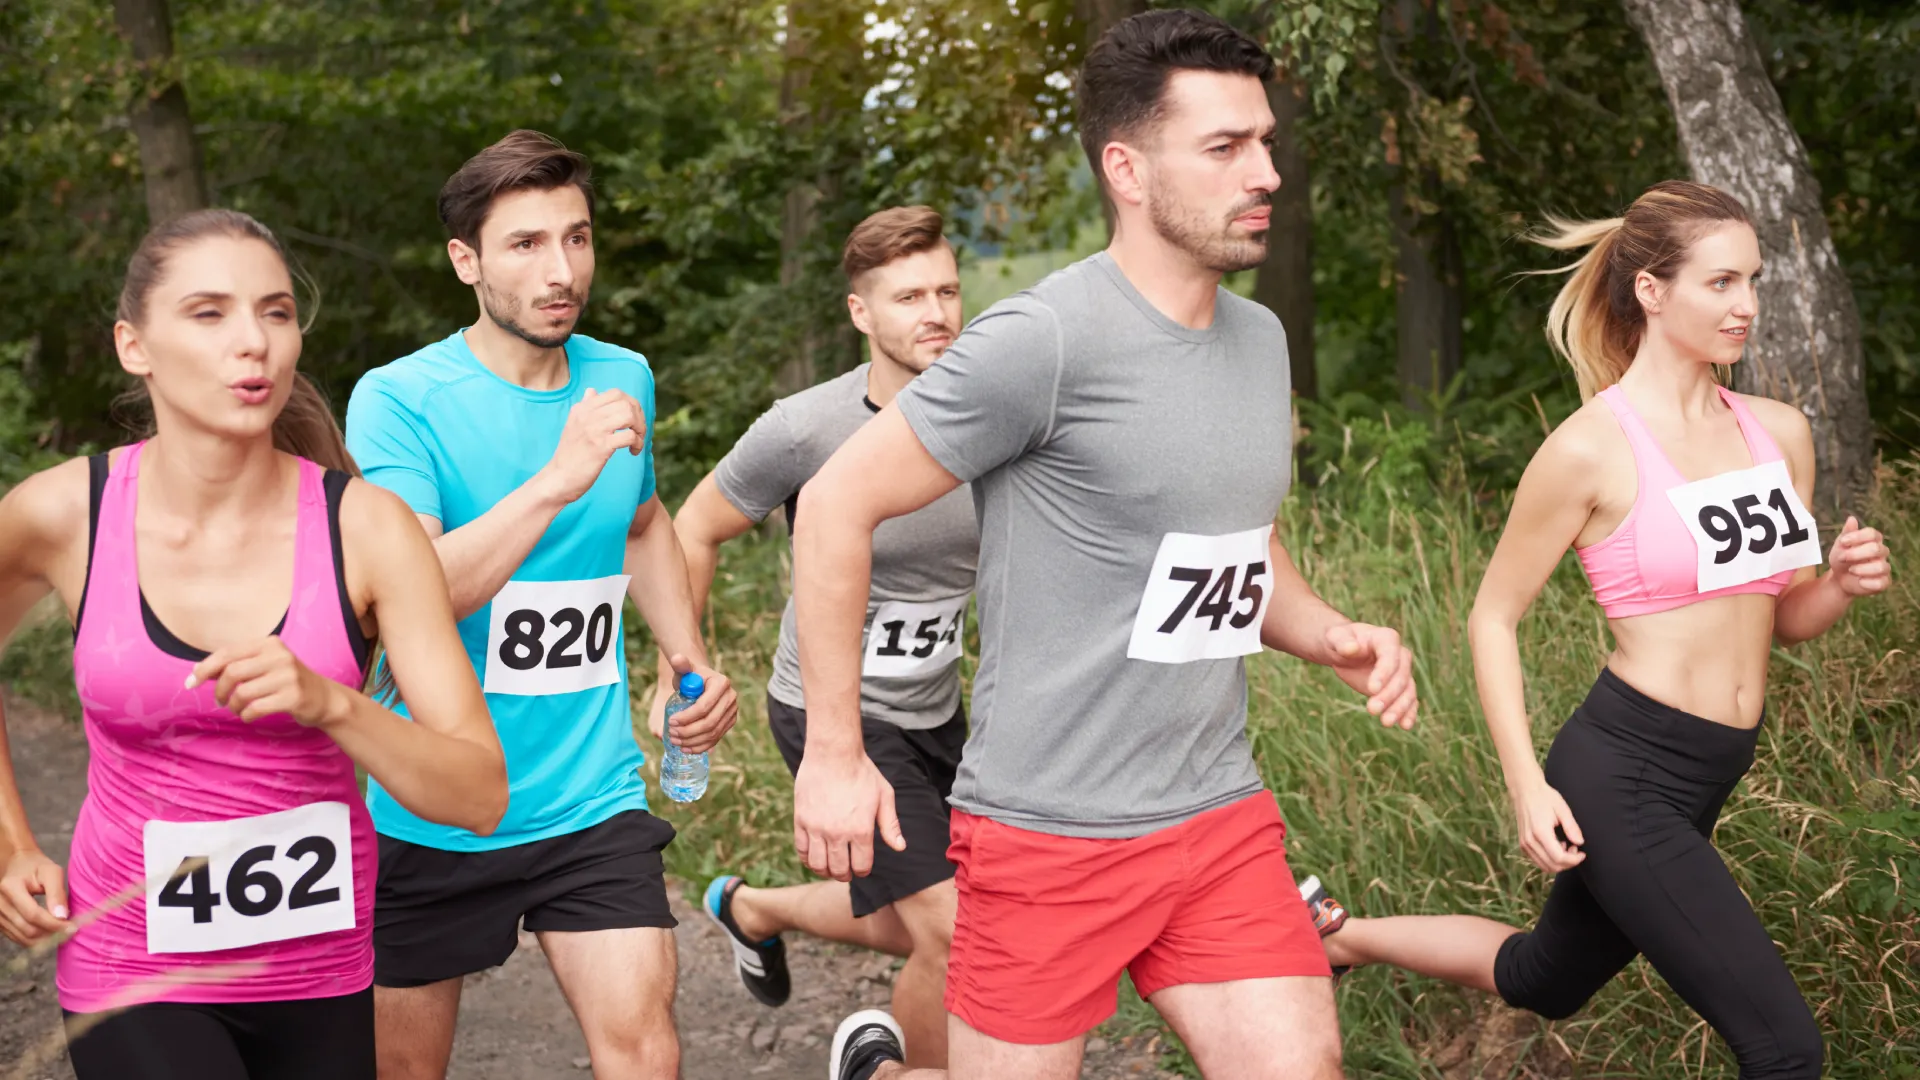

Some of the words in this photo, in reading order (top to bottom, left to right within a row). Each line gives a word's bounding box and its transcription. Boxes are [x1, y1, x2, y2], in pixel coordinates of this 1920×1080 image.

[1698, 488, 1809, 565] 951
[876, 608, 962, 659] 154
[1157, 561, 1266, 634] 745
[499, 602, 613, 671] 820
[158, 835, 340, 924] 462
